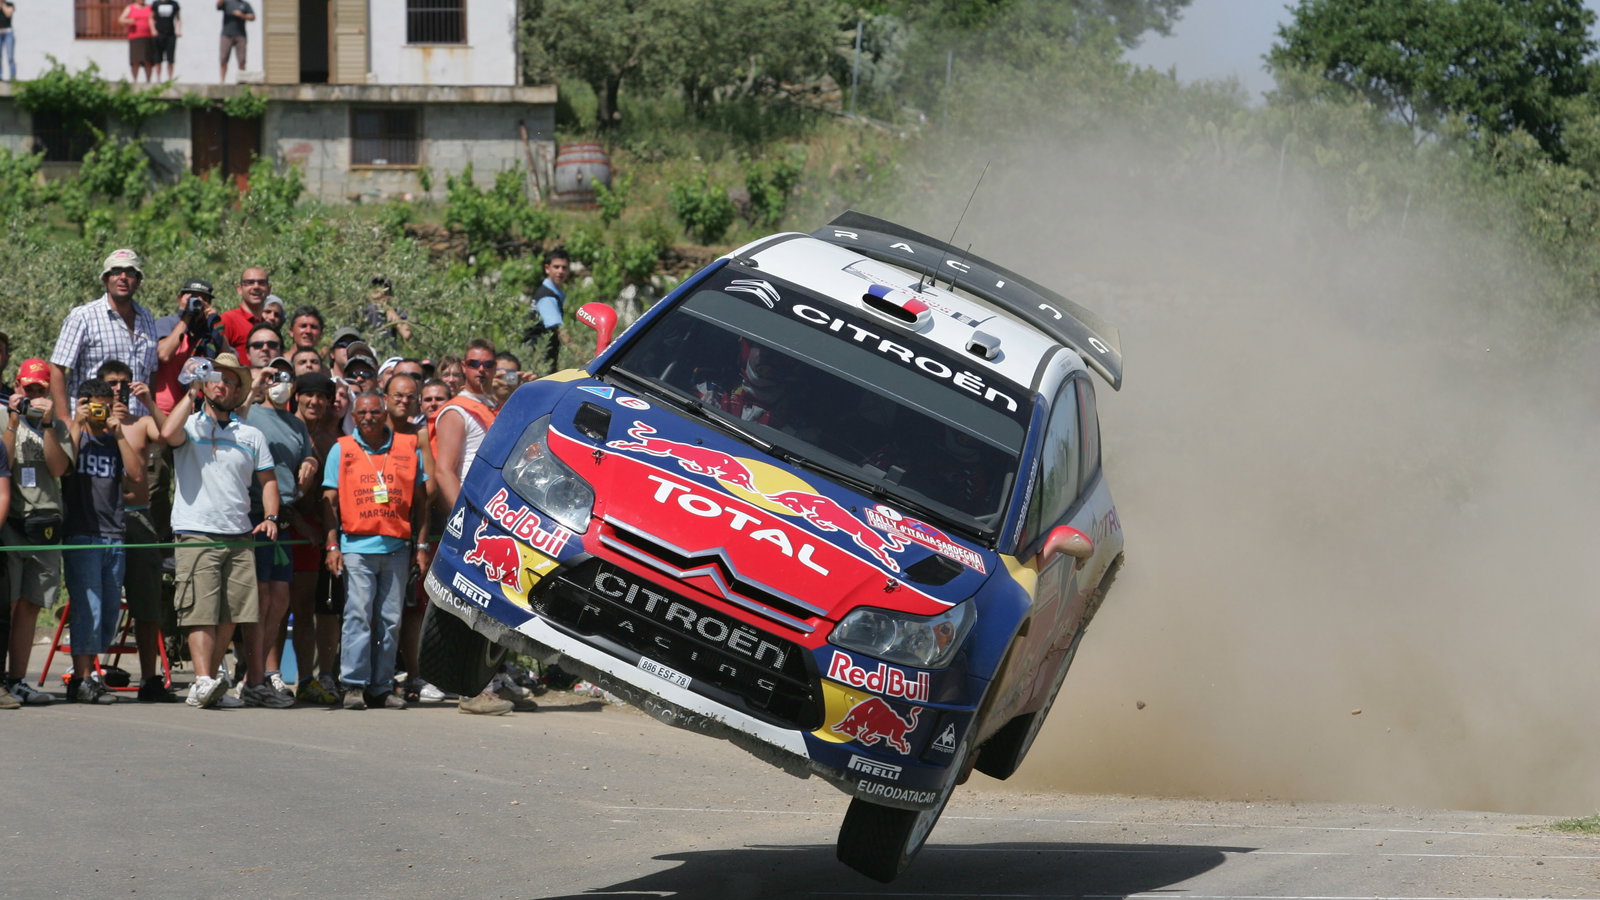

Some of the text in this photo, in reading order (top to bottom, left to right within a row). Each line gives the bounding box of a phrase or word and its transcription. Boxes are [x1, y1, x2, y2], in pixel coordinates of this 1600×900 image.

[834, 230, 1109, 354] RACING
[577, 307, 597, 326] TOTAL
[365, 496, 402, 505] PERSO
[648, 474, 831, 577] TOTAL
[869, 511, 898, 529] RALLY
[452, 571, 492, 608] PIRELLI
[641, 660, 687, 687] 886 ESF 78
[848, 754, 903, 781] PIRELLI
[857, 779, 936, 803] EURODATACAR
